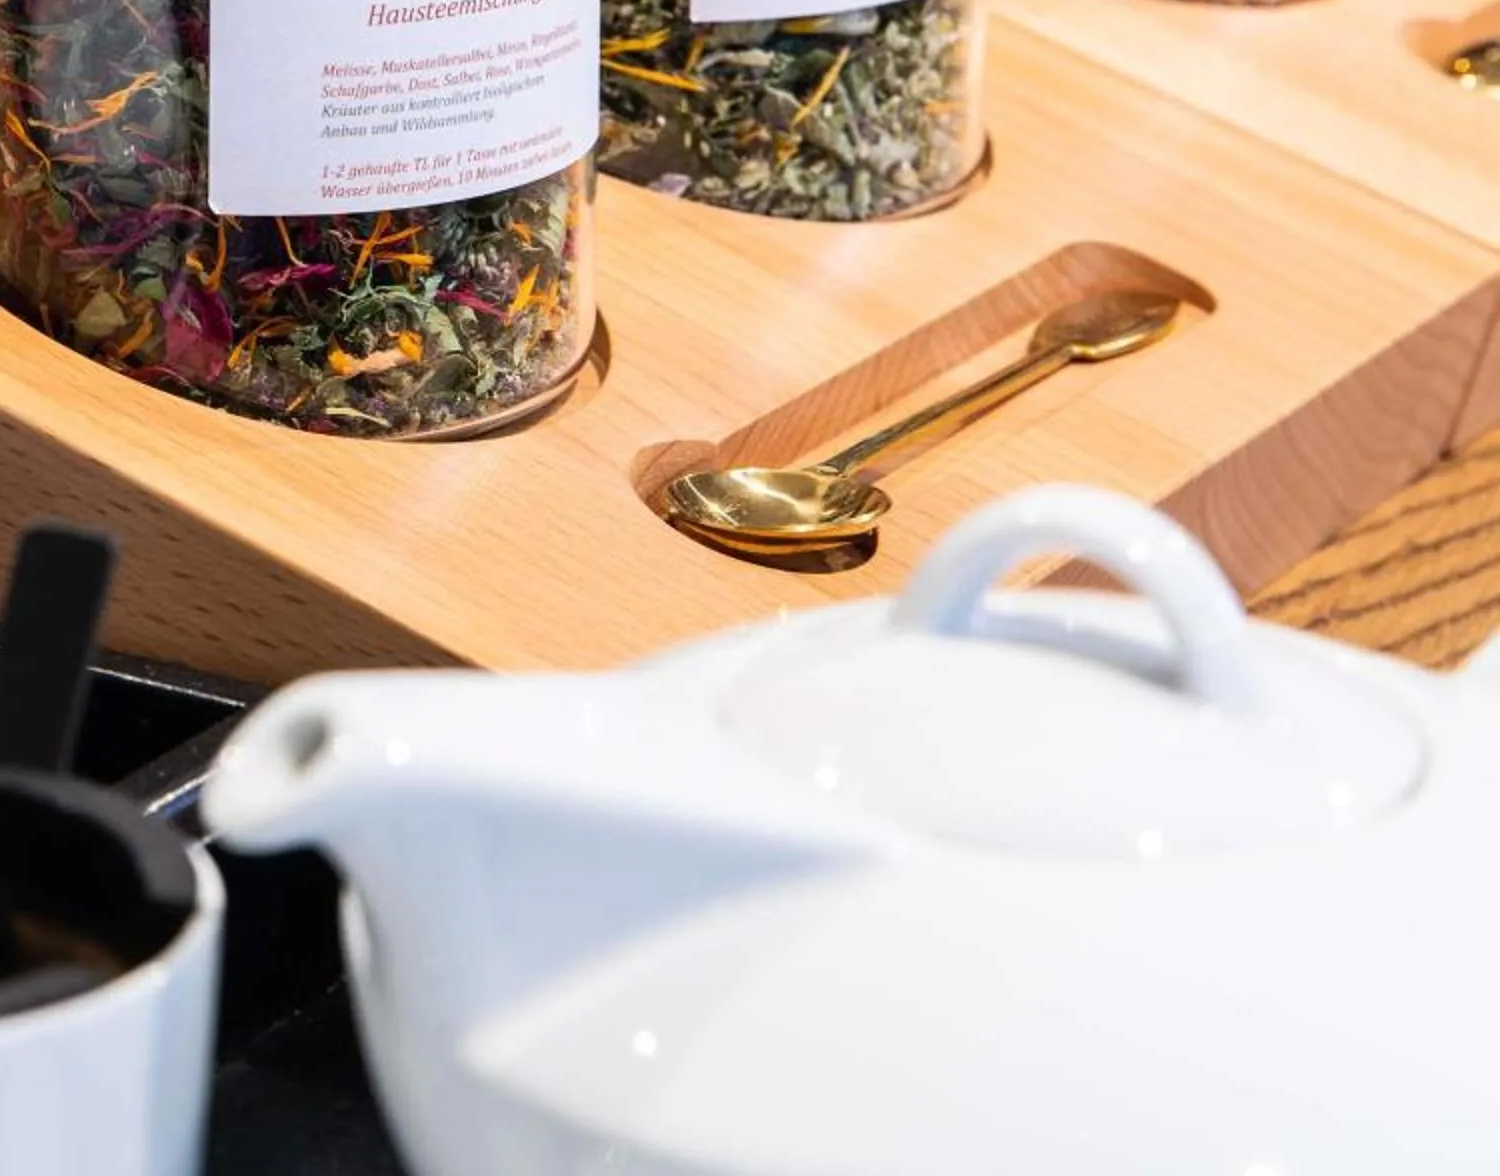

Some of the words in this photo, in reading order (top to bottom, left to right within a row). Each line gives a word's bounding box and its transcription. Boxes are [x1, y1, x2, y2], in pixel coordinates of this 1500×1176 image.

[321, 103, 378, 120] Kräuter
[381, 101, 405, 114] aus
[408, 90, 480, 112] kontrolliert
[320, 124, 367, 139] Anbau
[371, 121, 398, 136] und
[402, 107, 494, 132] Wildsammlung
[322, 164, 346, 181] 1-2
[413, 157, 430, 172] TL
[321, 184, 373, 200] Wasser
